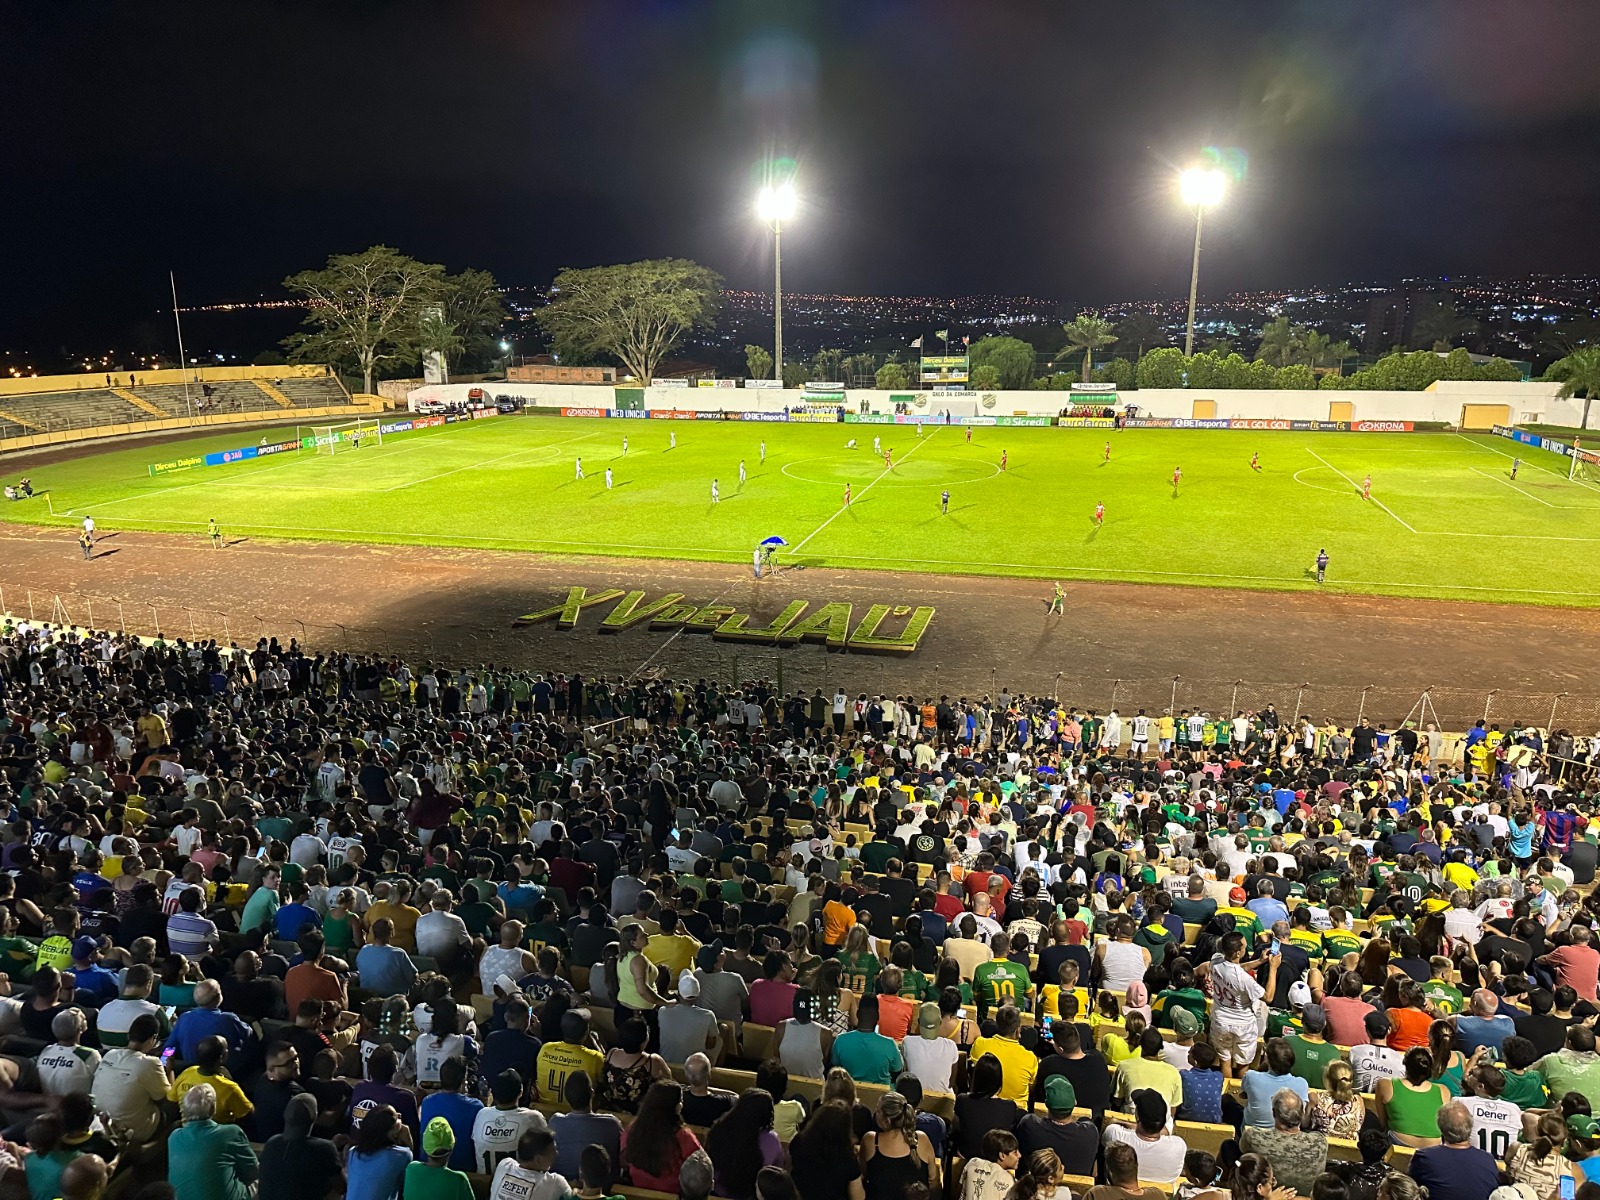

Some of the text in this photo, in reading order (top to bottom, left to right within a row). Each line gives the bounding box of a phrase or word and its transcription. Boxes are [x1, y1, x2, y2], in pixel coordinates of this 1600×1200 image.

[610, 409, 624, 418] MED
[625, 409, 646, 418] UNICID
[752, 413, 787, 422] BETesporte
[790, 414, 837, 422] eurofarma
[859, 414, 889, 423] Sicredi
[1013, 417, 1045, 426] Sicredi
[1060, 418, 1115, 427] eurofarma
[1184, 420, 1227, 428] BETesporte
[1232, 420, 1289, 429] GOL GOL GOL
[1310, 420, 1319, 430] fit
[1336, 421, 1345, 430] fit
[155, 462, 177, 472] Dirceu
[836, 696, 844, 705] 10
[732, 707, 742, 718] 10
[1138, 724, 1145, 734] 10
[1193, 723, 1202, 733] 10
[1255, 843, 1265, 856] 9
[669, 857, 686, 866] Dener
[1170, 881, 1188, 890] inte
[164, 896, 180, 916] 10
[991, 979, 1015, 1003] 10
[42, 1055, 75, 1070] crefisa
[1365, 1061, 1393, 1075] Midea
[548, 1068, 566, 1104] 4
[1476, 1107, 1508, 1121] Dener
[484, 1126, 515, 1137] Dener
[1478, 1127, 1510, 1161] 10
